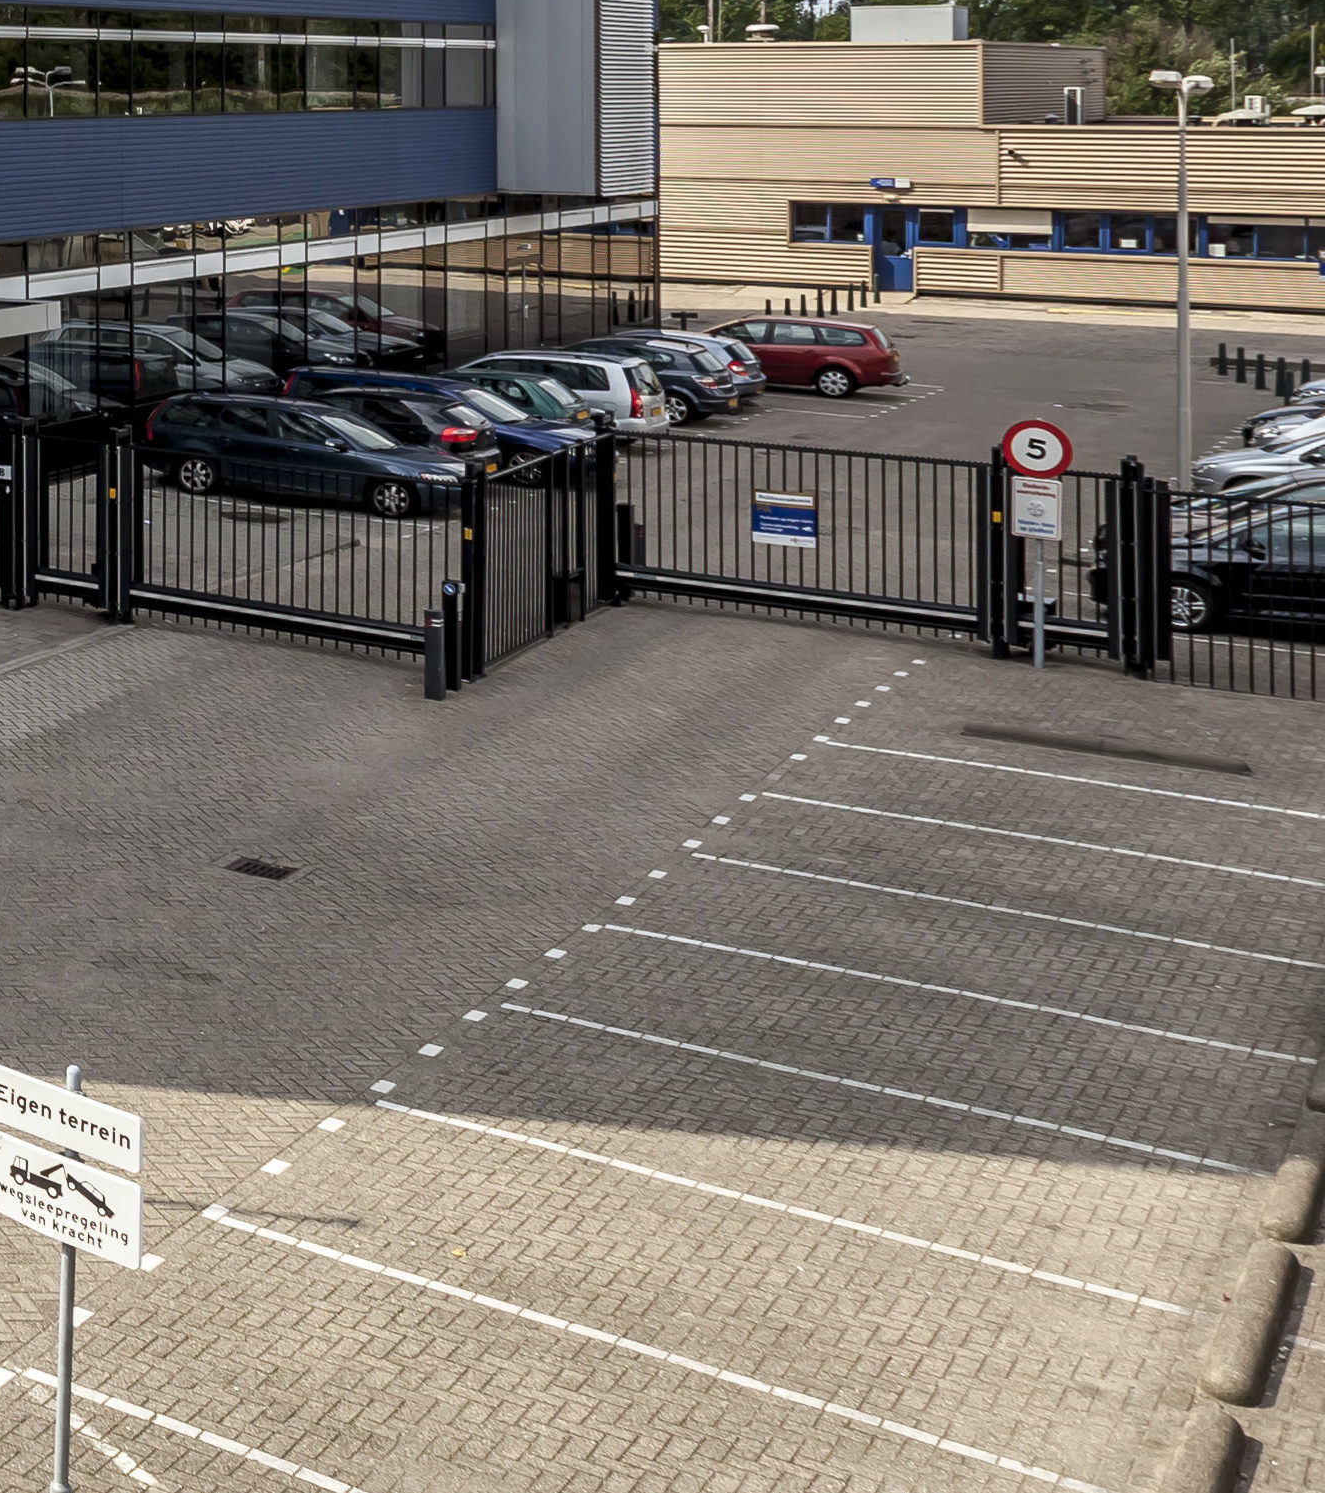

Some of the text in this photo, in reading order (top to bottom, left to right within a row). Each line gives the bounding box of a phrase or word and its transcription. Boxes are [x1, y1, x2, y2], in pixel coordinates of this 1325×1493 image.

[1025, 437, 1047, 460] 5
[59, 1108, 131, 1150] terrein
[0, 1181, 129, 1246] wegsleepregeling
[21, 1208, 103, 1249] van kracht
